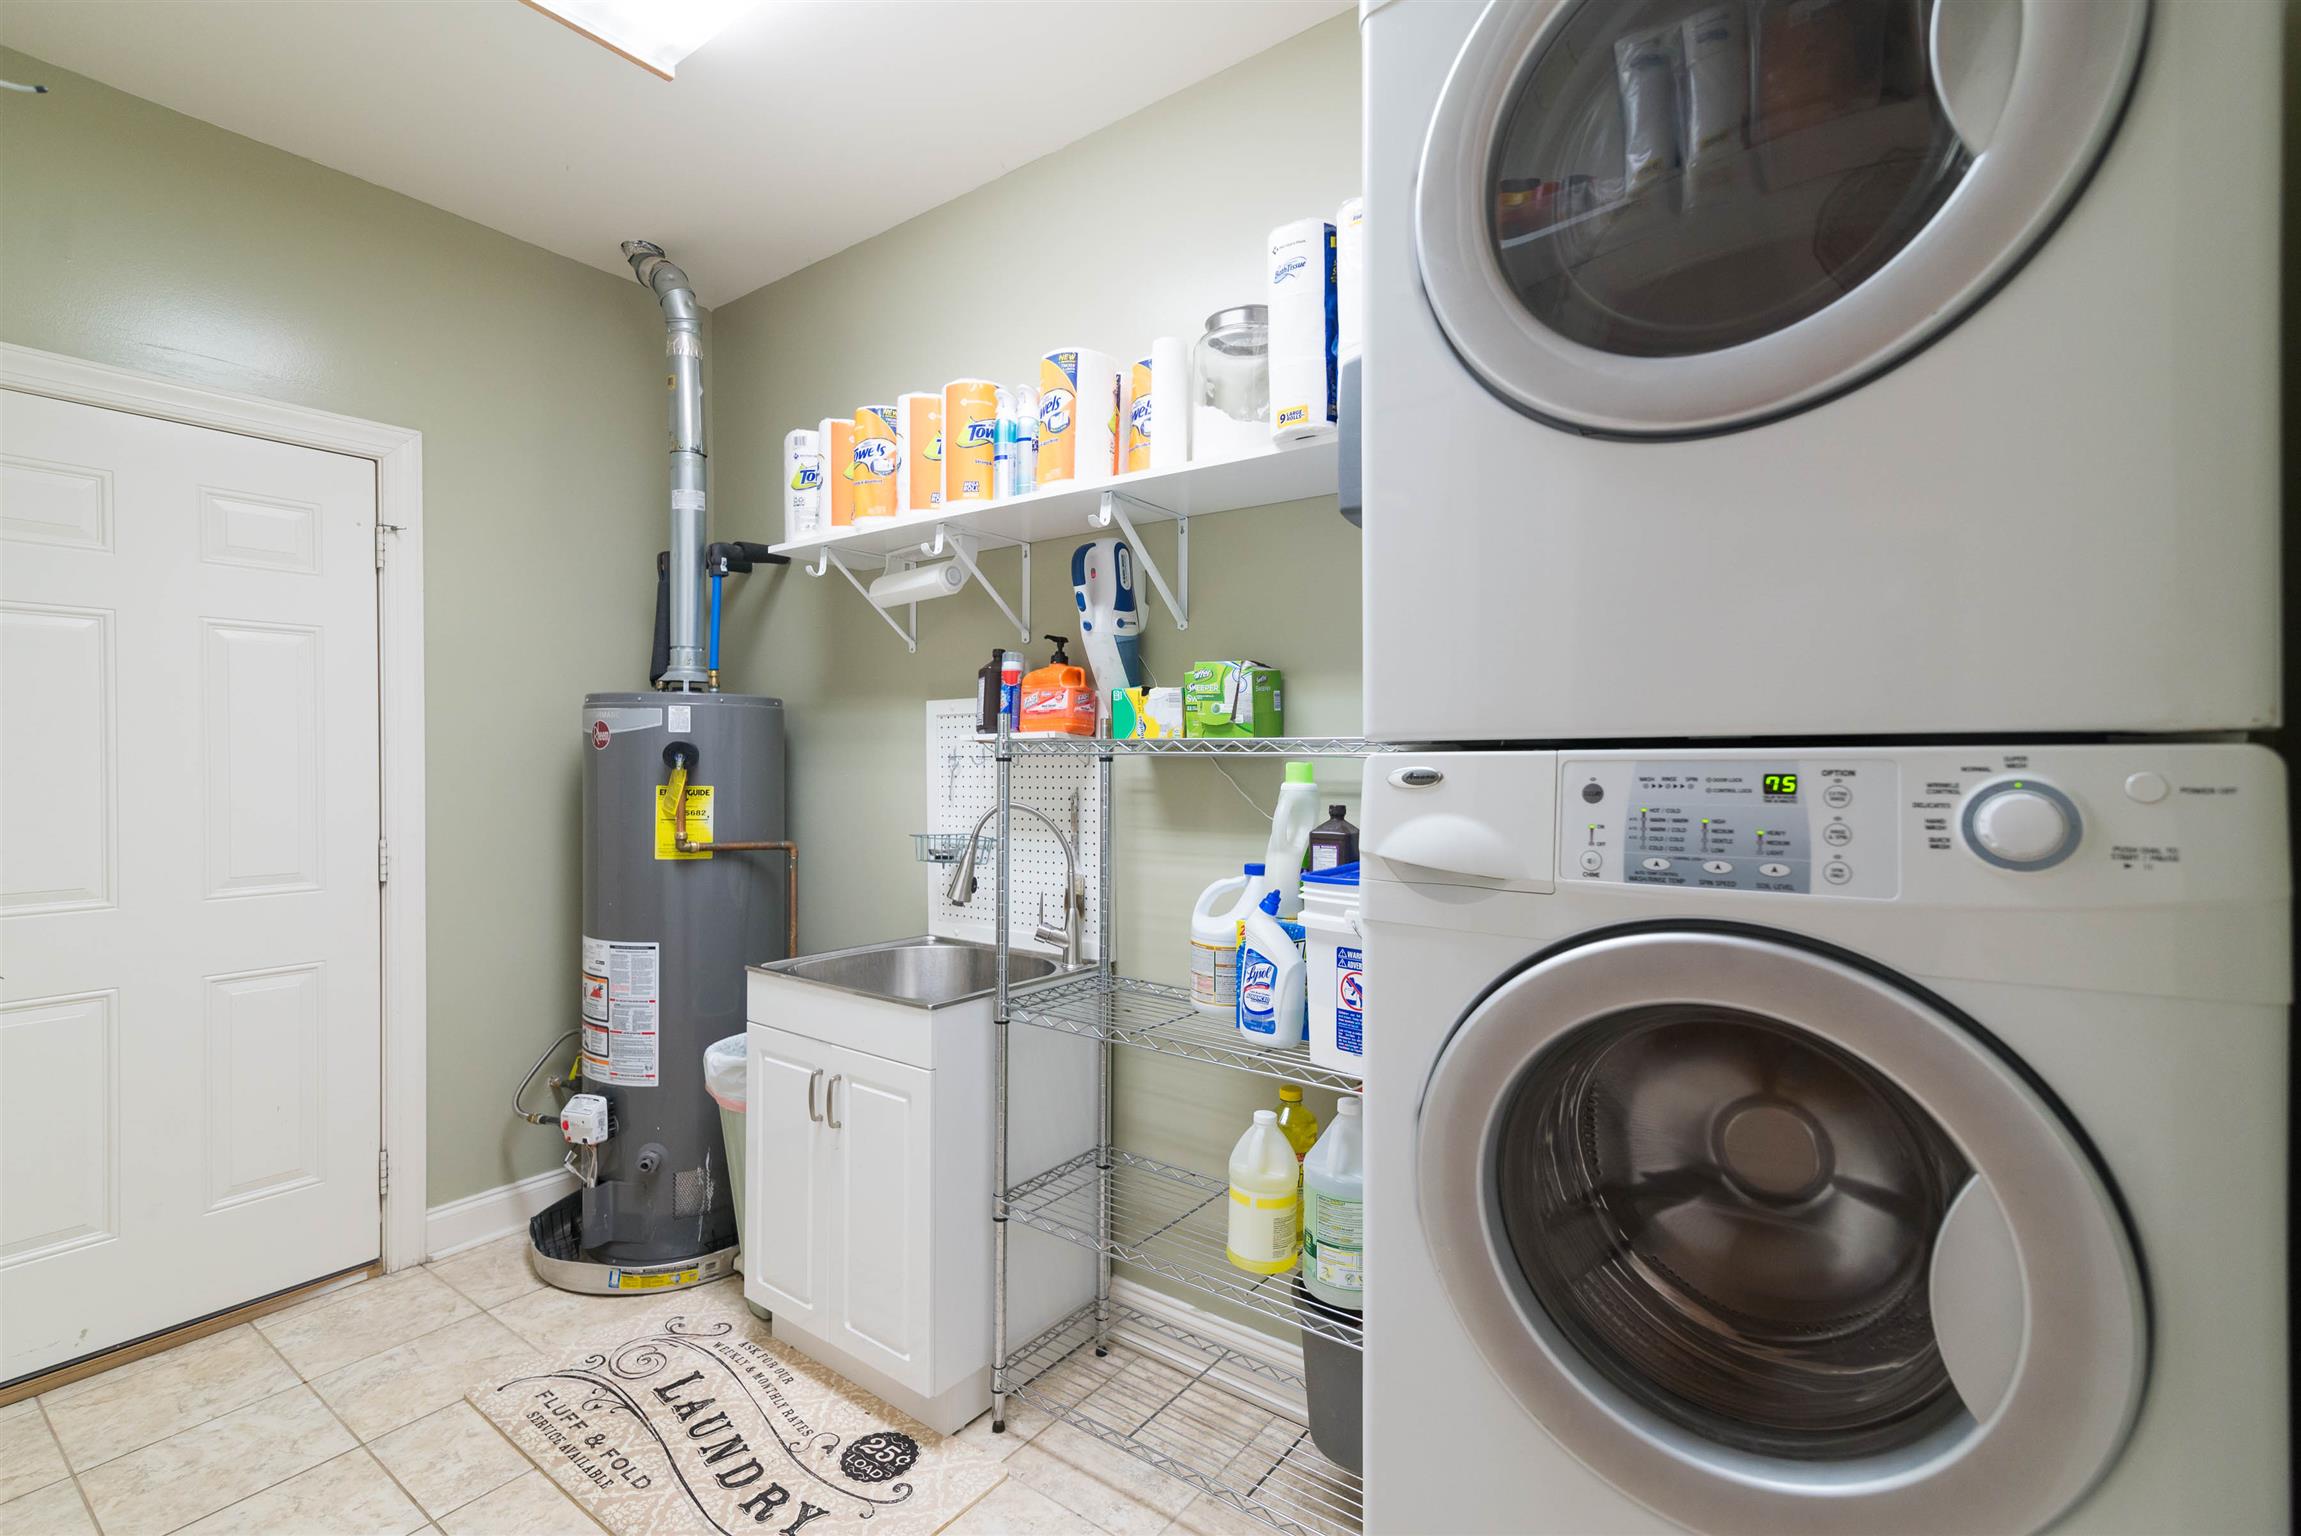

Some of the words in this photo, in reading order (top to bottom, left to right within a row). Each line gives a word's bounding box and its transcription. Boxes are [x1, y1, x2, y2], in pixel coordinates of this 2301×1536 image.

[1279, 413, 1286, 425] 9
[1765, 776, 1797, 793] 75
[1821, 769, 1857, 777] OPTION
[1246, 964, 1273, 985] Lysol
[738, 1341, 760, 1355] ASK
[757, 1353, 778, 1369] FOR
[774, 1367, 794, 1385] OUR
[713, 1341, 751, 1366] WEEKLY
[745, 1366, 757, 1374] &
[752, 1372, 790, 1409] MONTHLY
[782, 1408, 814, 1437] RATES
[526, 1410, 567, 1446] SERVICE
[559, 1443, 615, 1490] AVAILABLE
[535, 1389, 589, 1430] FLUFF
[584, 1433, 606, 1449] &
[599, 1447, 652, 1490] FOLD
[651, 1369, 830, 1536] LAUNDRY
[860, 1438, 911, 1467] 25¢
[846, 1454, 883, 1478] LOAD
